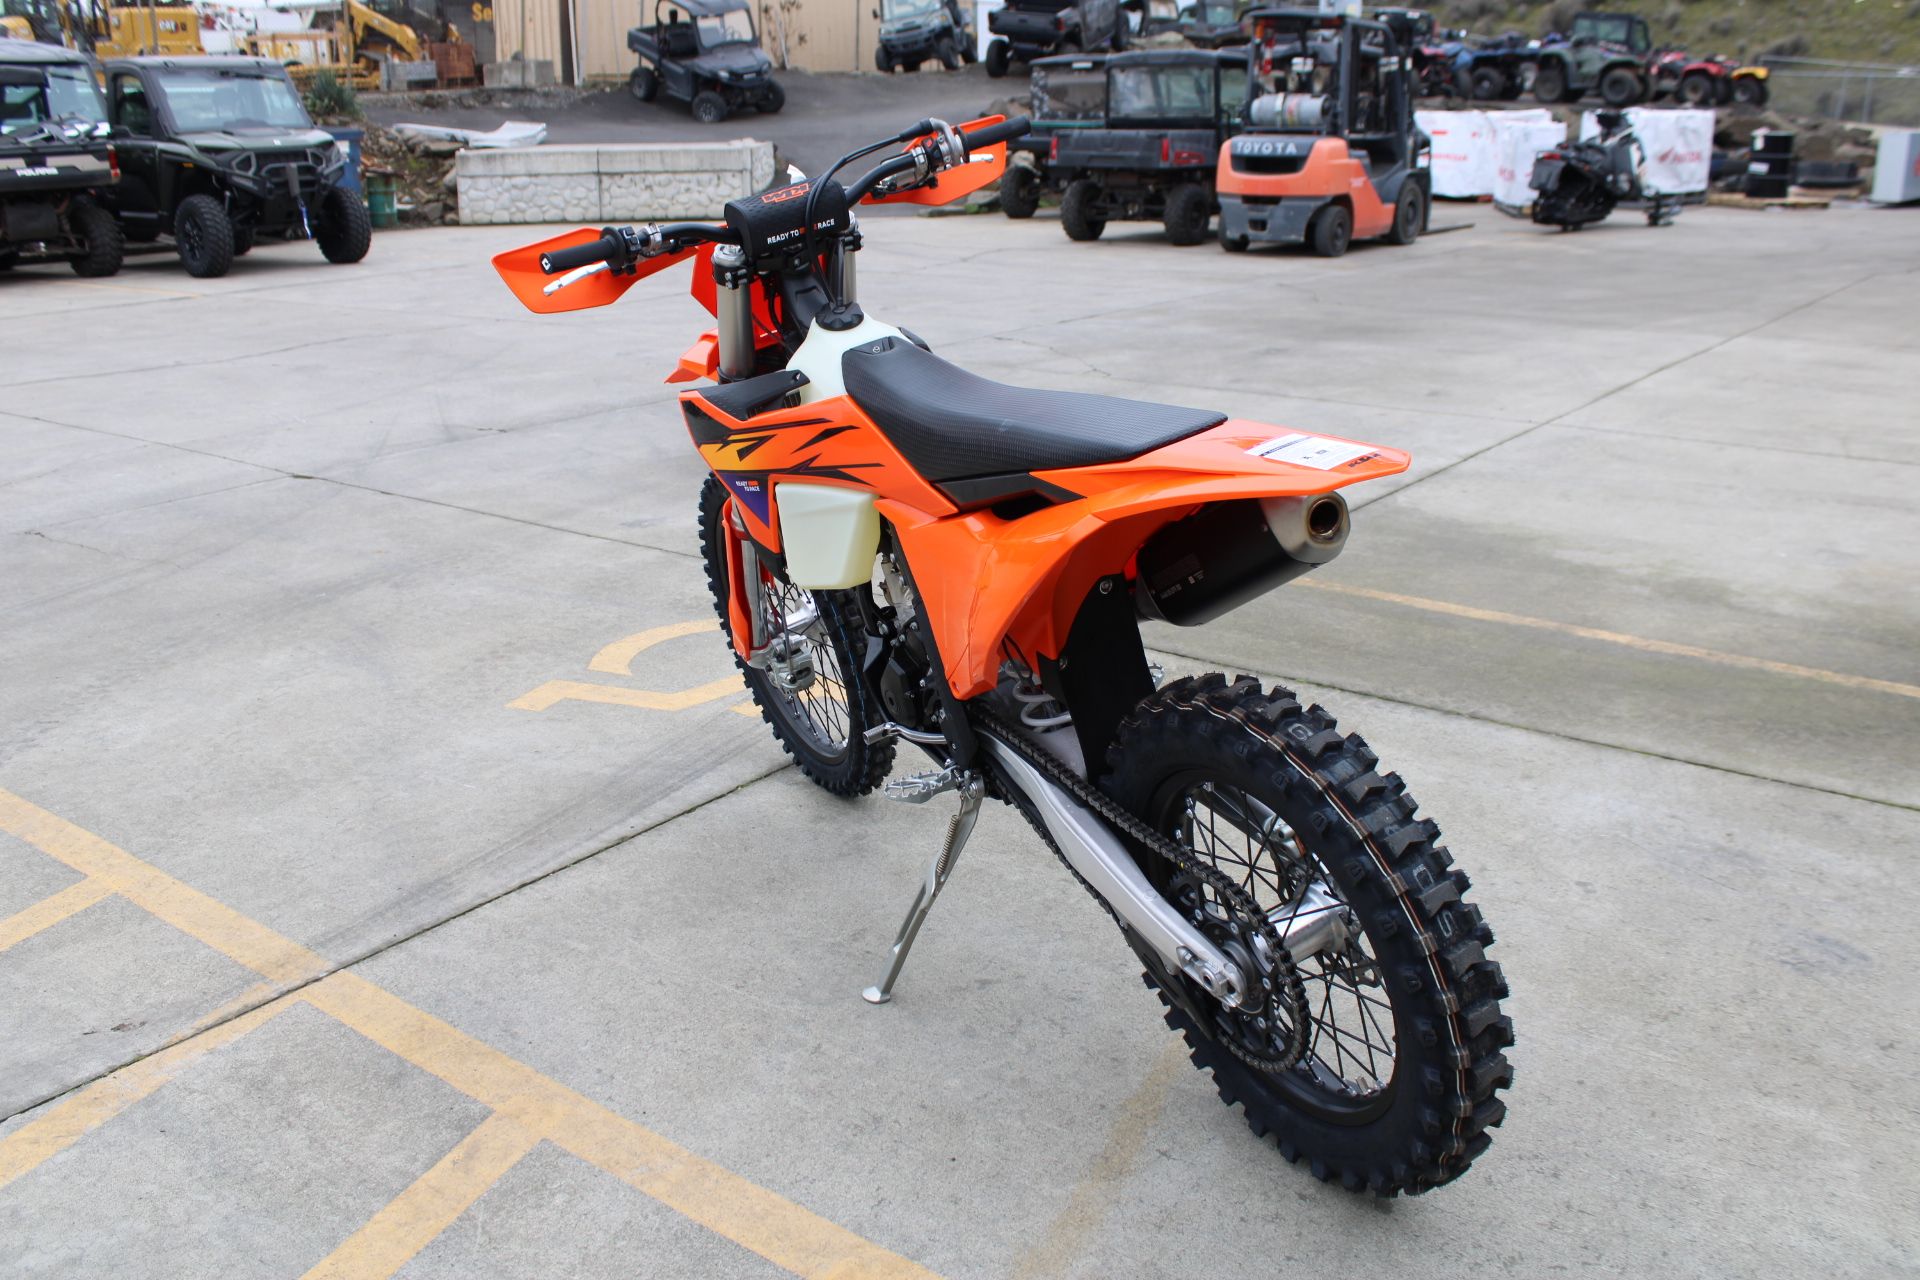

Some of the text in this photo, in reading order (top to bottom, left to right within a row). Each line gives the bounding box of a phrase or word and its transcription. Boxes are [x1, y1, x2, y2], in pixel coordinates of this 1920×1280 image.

[1236, 142, 1298, 155] TOYOTA
[767, 218, 835, 244] READY TO RACE
